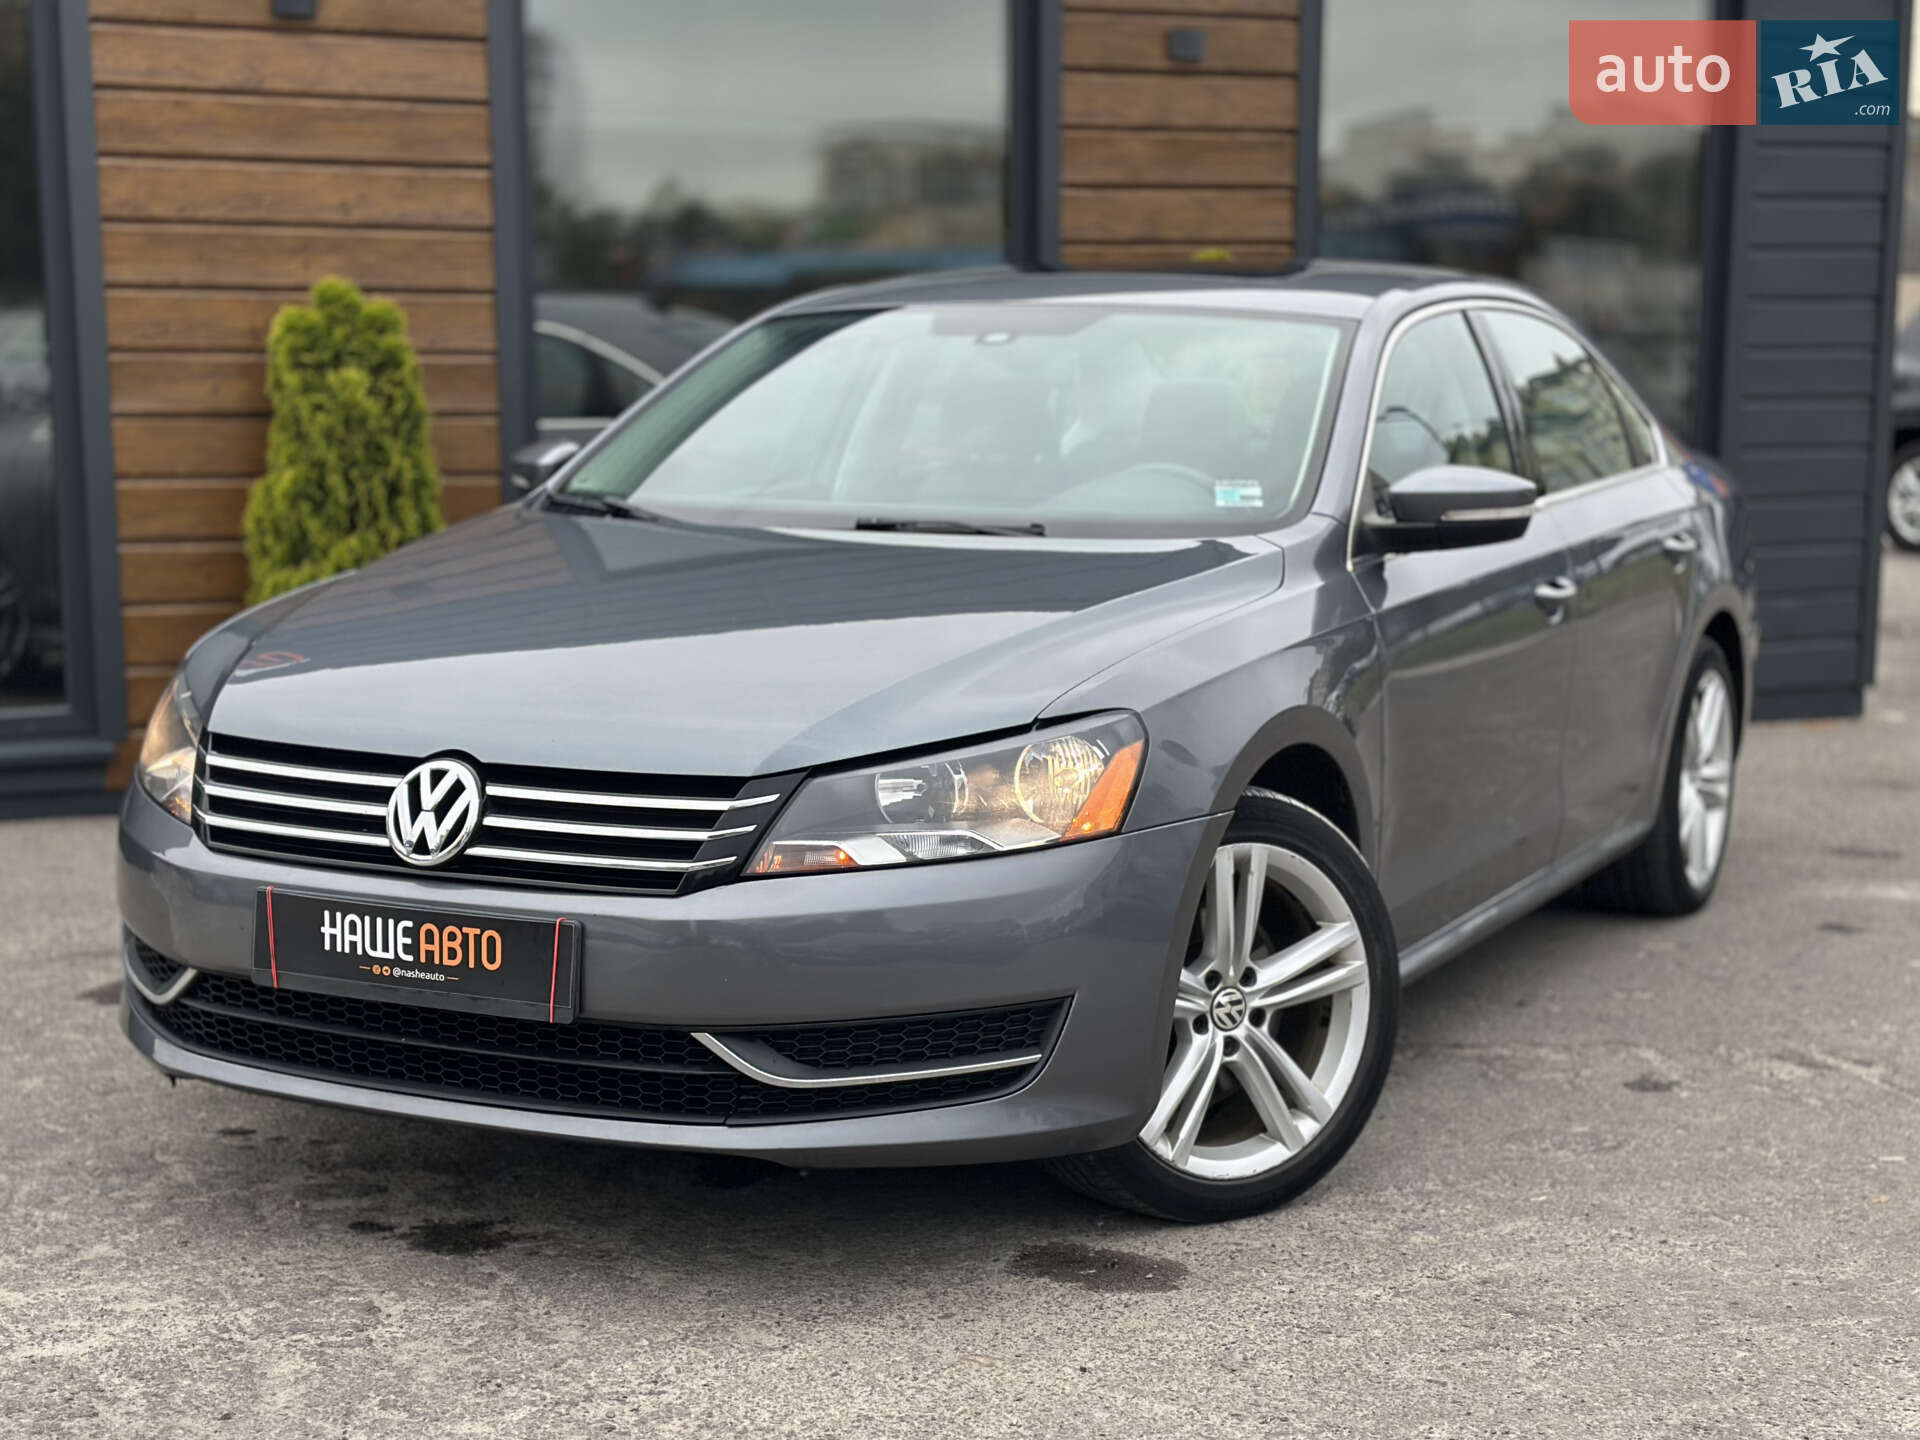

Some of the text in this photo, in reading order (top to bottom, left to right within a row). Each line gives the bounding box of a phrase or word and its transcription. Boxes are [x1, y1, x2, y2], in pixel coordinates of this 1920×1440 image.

[320, 909, 503, 971] НАШЕ АВТО
[392, 966, 445, 981] @nasheauto
